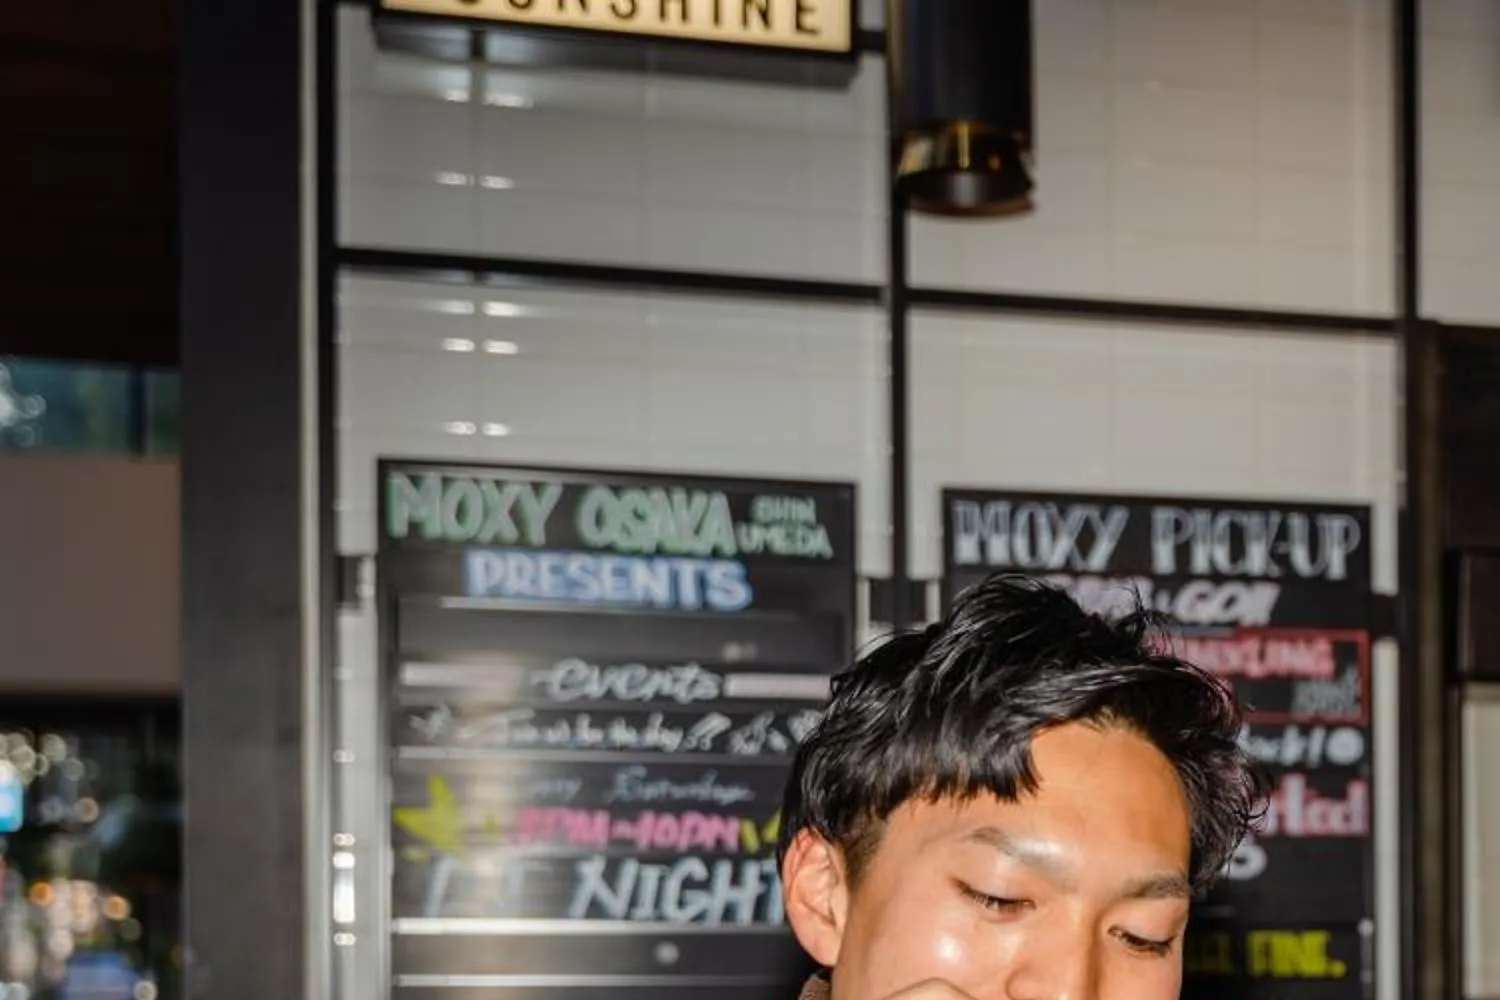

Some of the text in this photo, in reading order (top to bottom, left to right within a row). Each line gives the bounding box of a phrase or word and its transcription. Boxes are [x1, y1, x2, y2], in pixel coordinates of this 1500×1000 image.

[388, 473, 739, 557] MOXY OSAKA
[954, 501, 1128, 571] MOXY
[462, 548, 753, 612] PRESENTS
